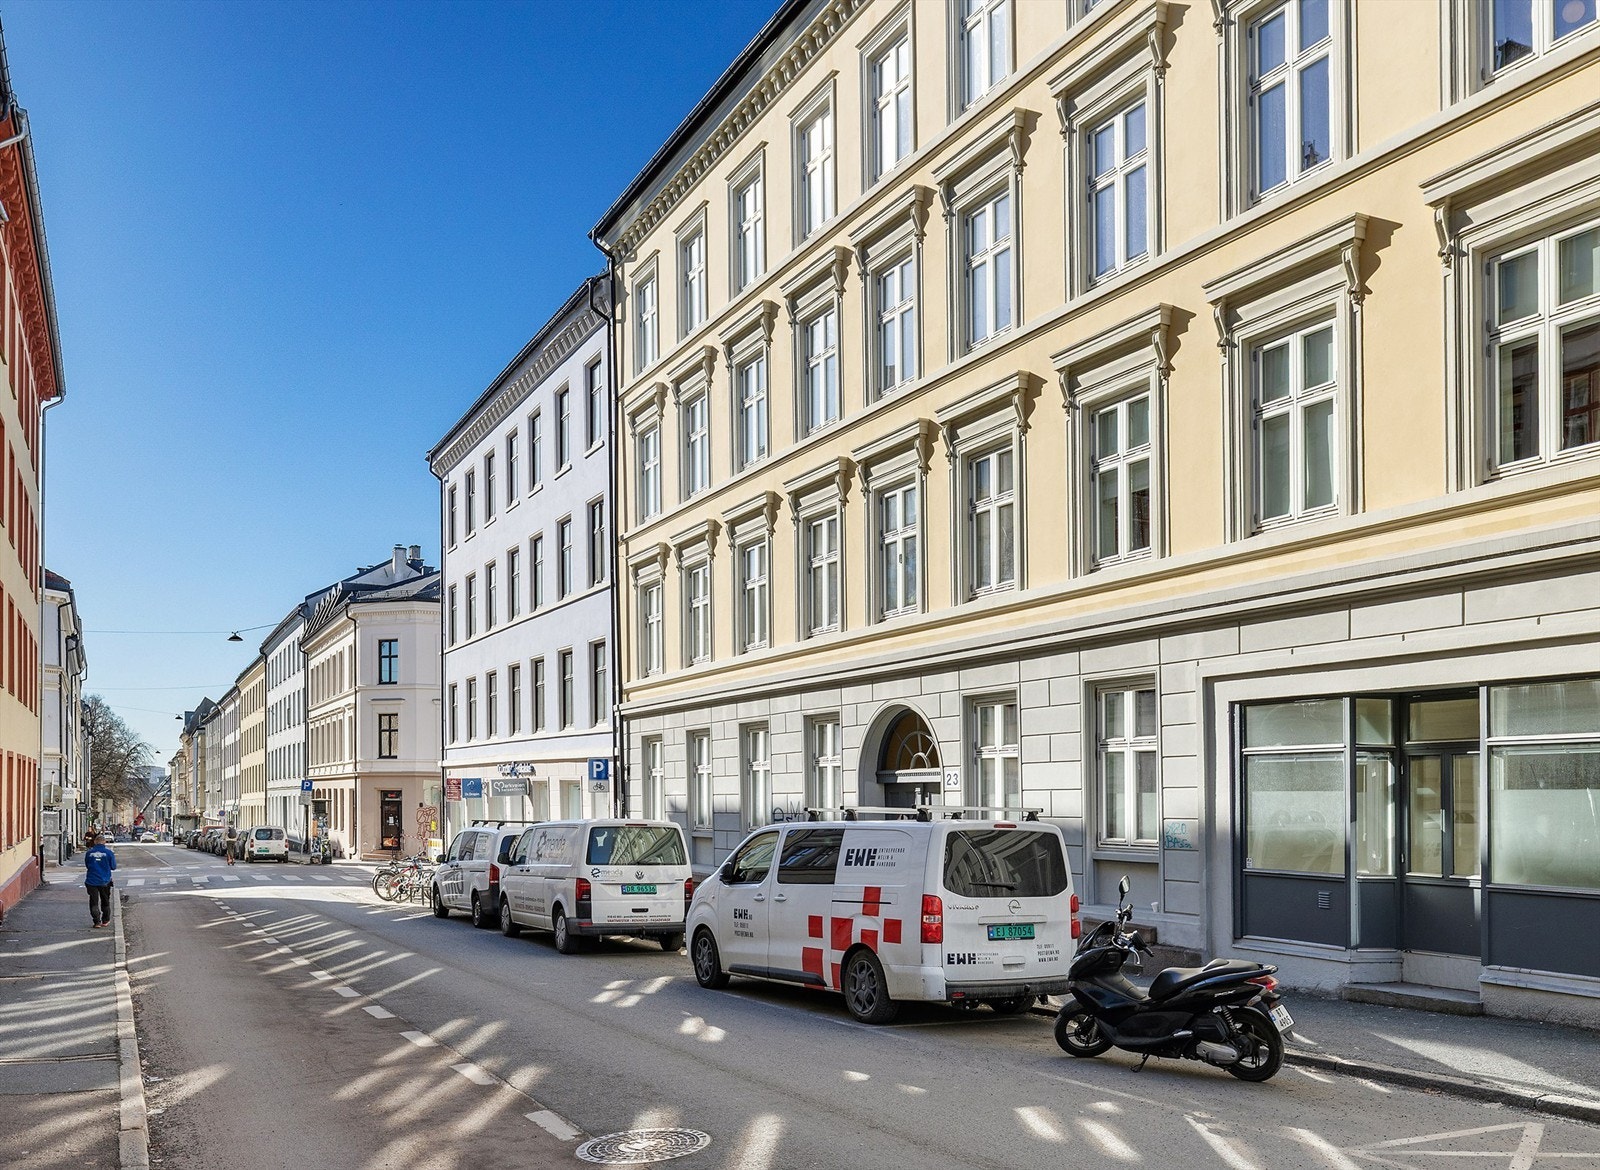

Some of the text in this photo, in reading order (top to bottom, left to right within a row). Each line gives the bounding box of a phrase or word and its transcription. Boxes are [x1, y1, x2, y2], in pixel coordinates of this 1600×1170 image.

[593, 762, 604, 778] P
[946, 773, 959, 786] 23
[845, 848, 878, 867] EWH
[995, 926, 1033, 937] EJ 87054
[946, 953, 977, 965] EWH
